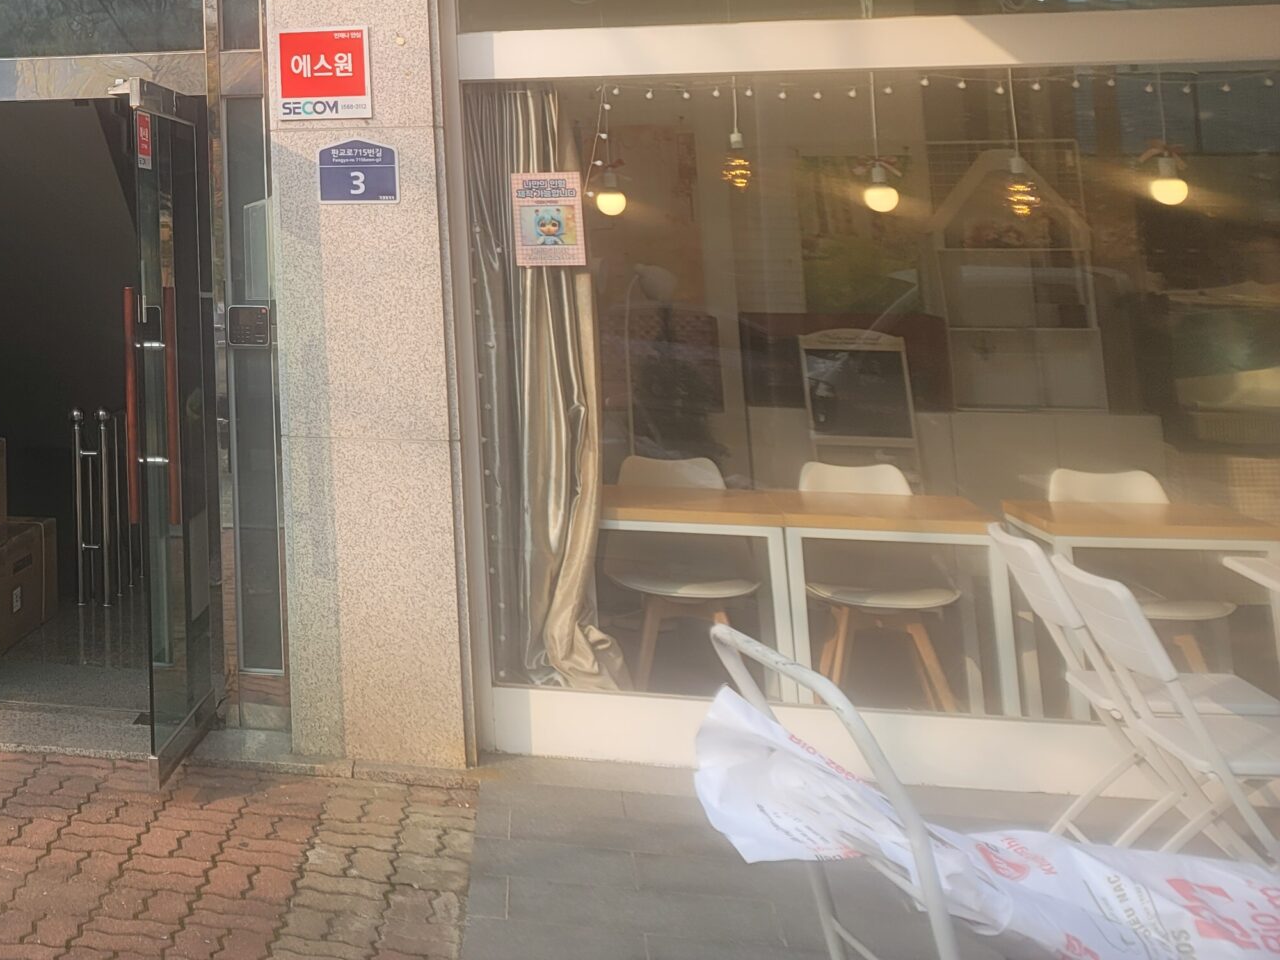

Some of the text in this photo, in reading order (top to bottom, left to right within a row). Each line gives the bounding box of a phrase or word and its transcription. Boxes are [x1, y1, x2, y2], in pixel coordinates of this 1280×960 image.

[291, 53, 353, 78] 에스원
[282, 100, 339, 115] SECOM
[350, 171, 366, 195] 3
